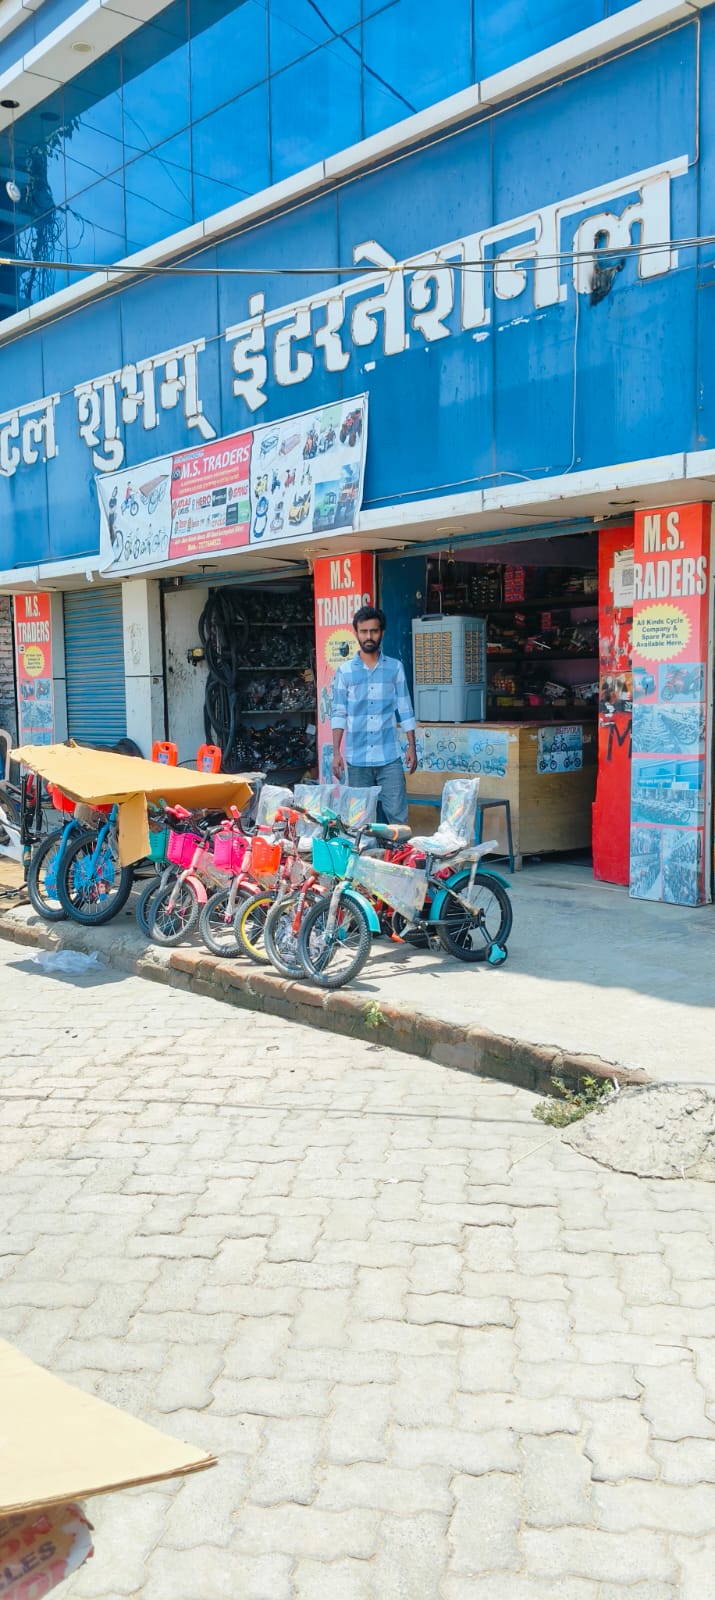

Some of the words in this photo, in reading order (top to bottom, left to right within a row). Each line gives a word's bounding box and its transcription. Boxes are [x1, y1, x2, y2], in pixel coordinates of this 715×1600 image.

[225, 154, 689, 412] इंटरनेशनल
[180, 458, 201, 480] M.S.
[203, 443, 251, 473] TRADERS
[642, 511, 685, 554] M.S.
[329, 558, 355, 590] M.S.
[25, 596, 41, 618] M.S.
[18, 620, 50, 643] TRADERS
[636, 618, 646, 627] All
[646, 618, 664, 626] Kinds
[665, 617, 684, 626] Cycle
[641, 625, 671, 634] Company
[636, 641, 664, 649] Available
[641, 633, 660, 641] Spare
